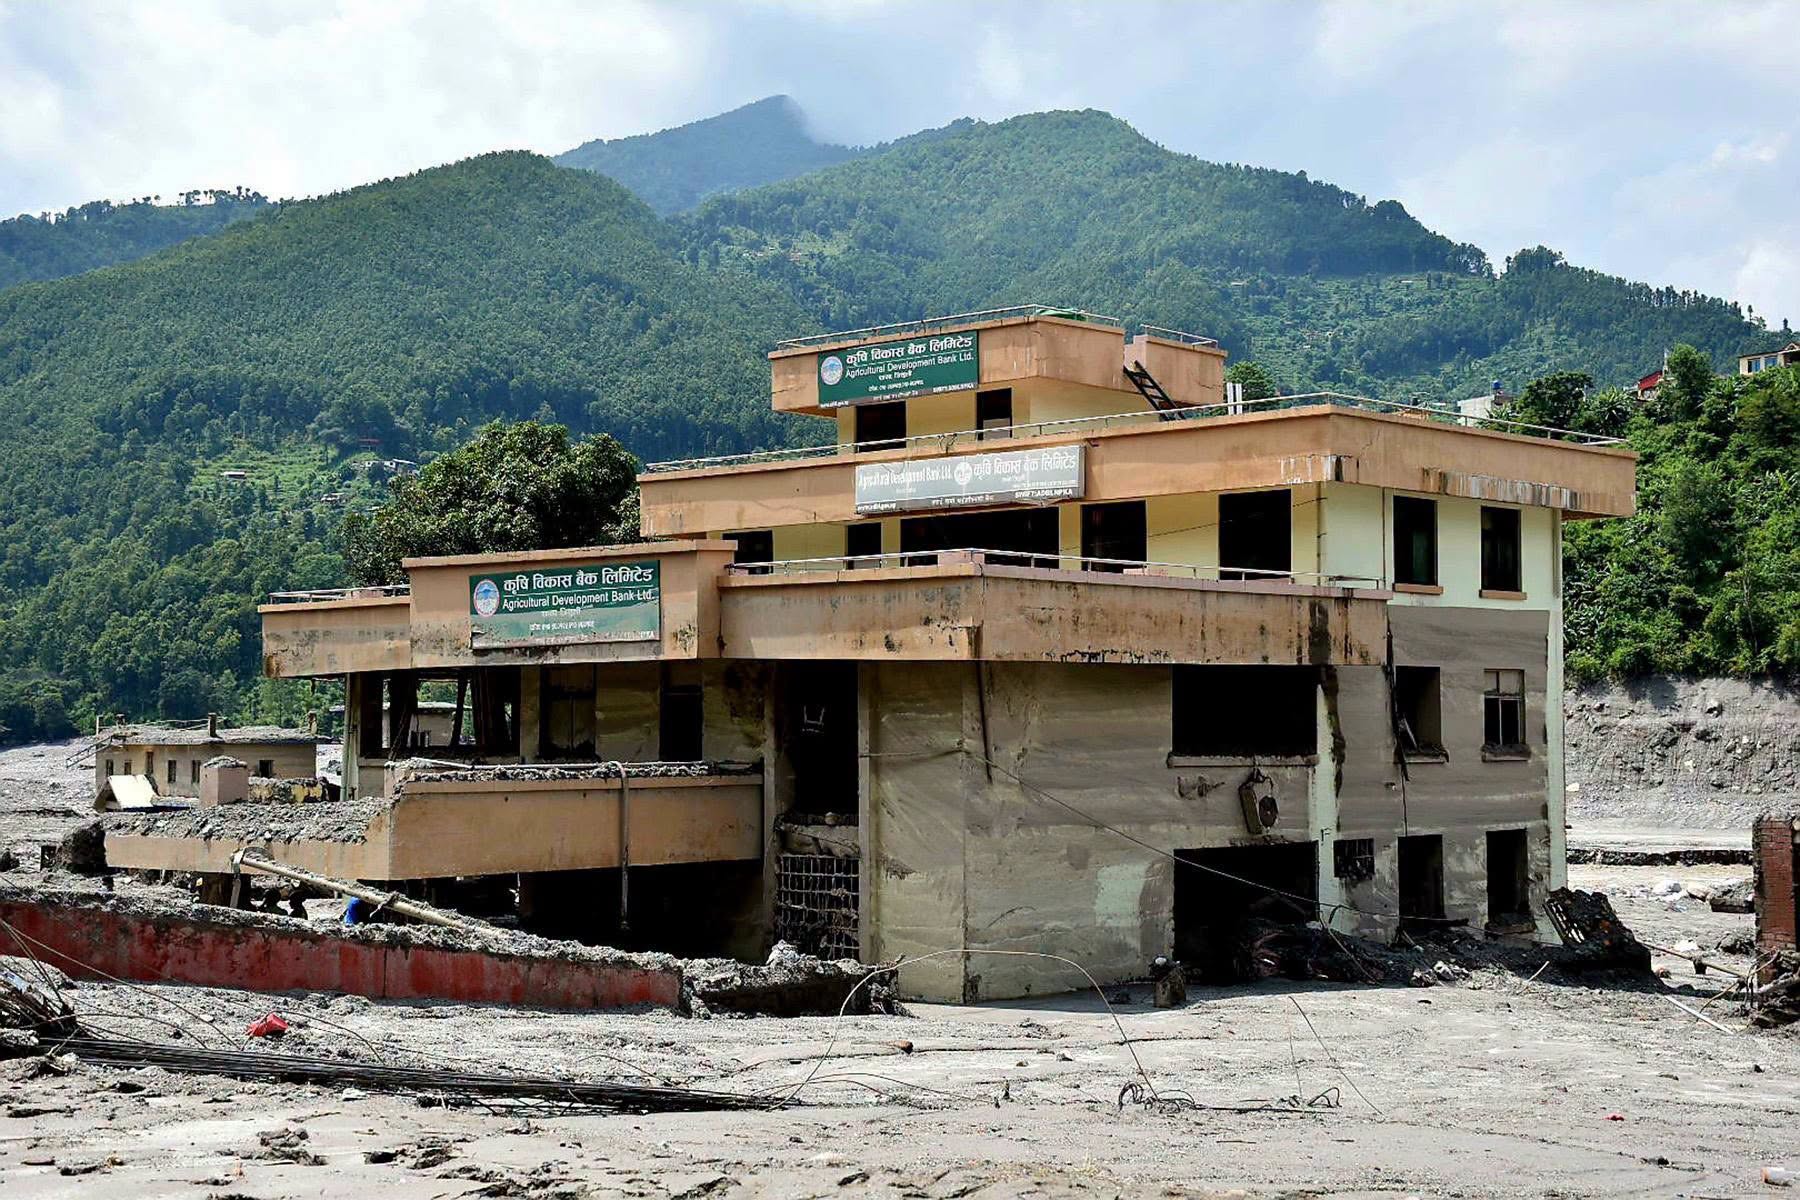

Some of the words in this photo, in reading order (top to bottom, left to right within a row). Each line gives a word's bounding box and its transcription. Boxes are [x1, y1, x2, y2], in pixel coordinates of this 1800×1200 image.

[845, 363, 885, 379] Agricultural
[887, 356, 936, 372] Development
[937, 354, 957, 364] Bank
[959, 351, 974, 361] Ltd.
[846, 350, 868, 367] कृषि
[871, 347, 905, 361] विकास
[929, 335, 974, 352] लिमिटेड
[993, 456, 1022, 475] विकास
[1041, 451, 1078, 472] लिमिटेड
[503, 575, 529, 595] कृषि
[532, 573, 573, 589] विकास
[601, 565, 654, 585] लिमिटेड
[502, 595, 550, 611] Agricultural
[552, 592, 609, 607] Development
[611, 589, 634, 601] Bank
[637, 589, 656, 601] Ltd.
